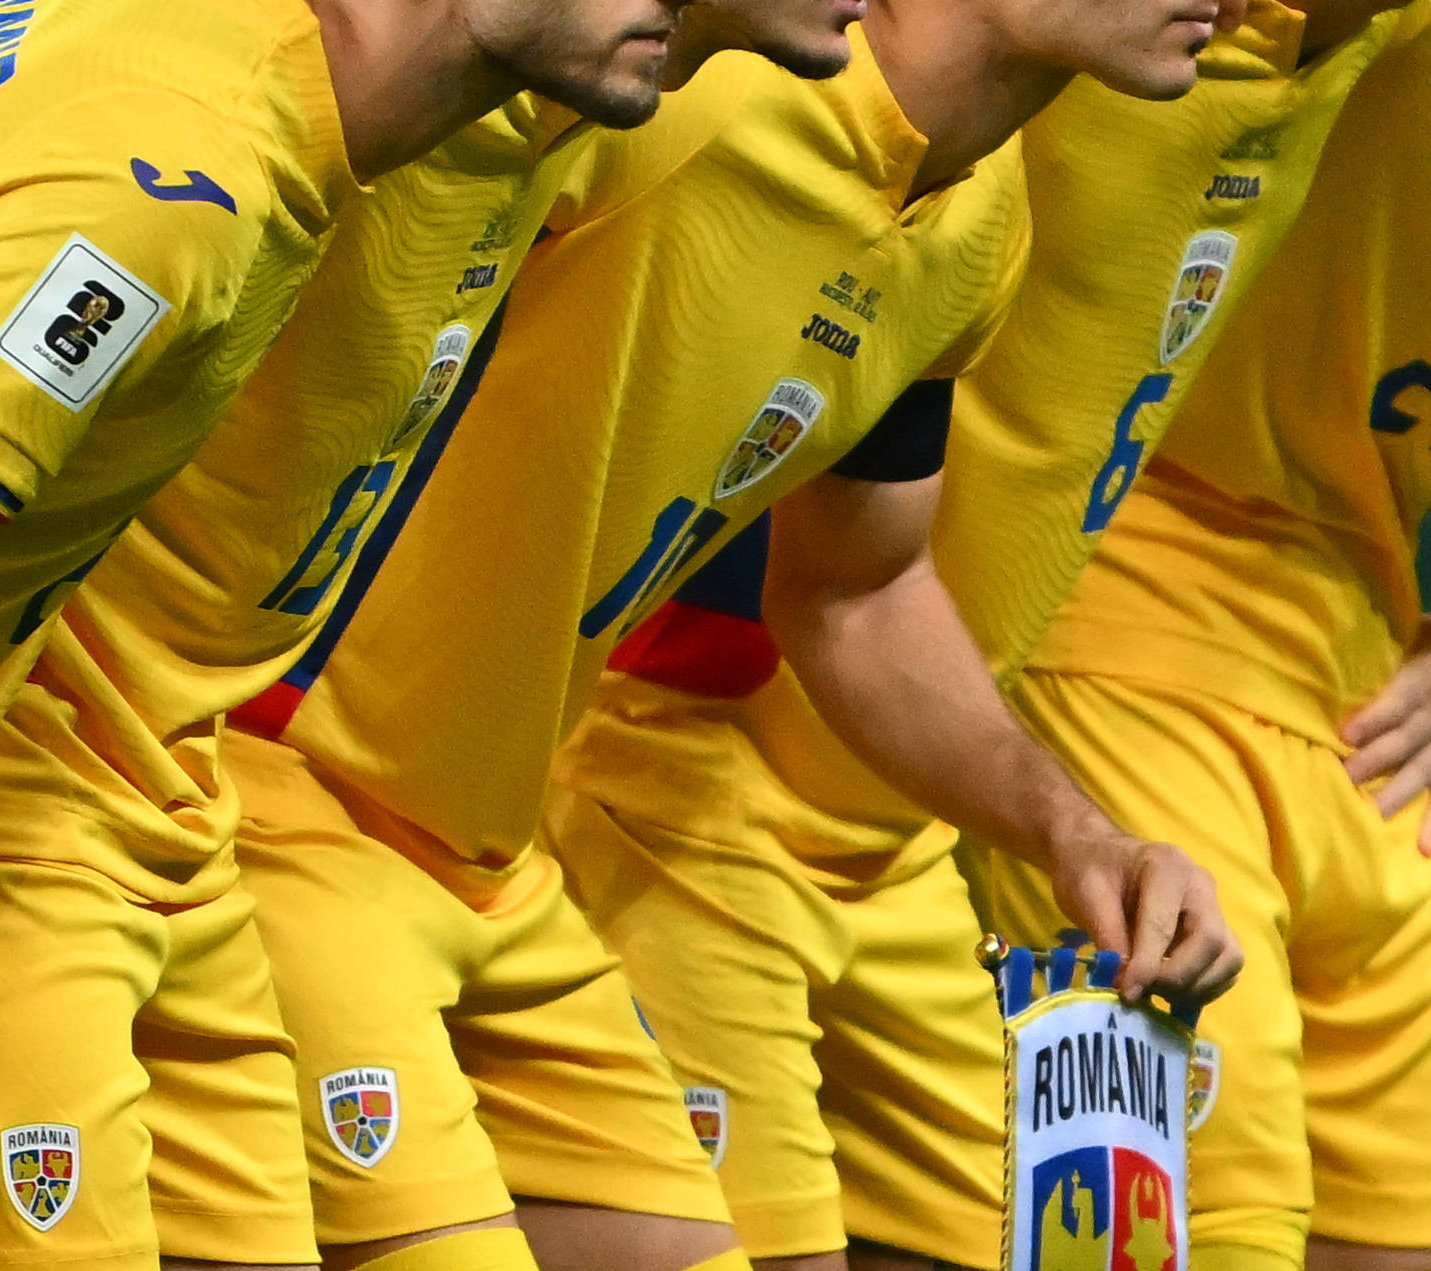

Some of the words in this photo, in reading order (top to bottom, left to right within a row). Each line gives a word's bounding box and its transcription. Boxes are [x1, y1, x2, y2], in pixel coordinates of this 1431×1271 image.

[1081, 373, 1174, 533] 6
[327, 1069, 388, 1095] ROMÂNIA
[1033, 1012, 1169, 1140] ROMÂNIA
[8, 1126, 71, 1149] ROMÂNIA
